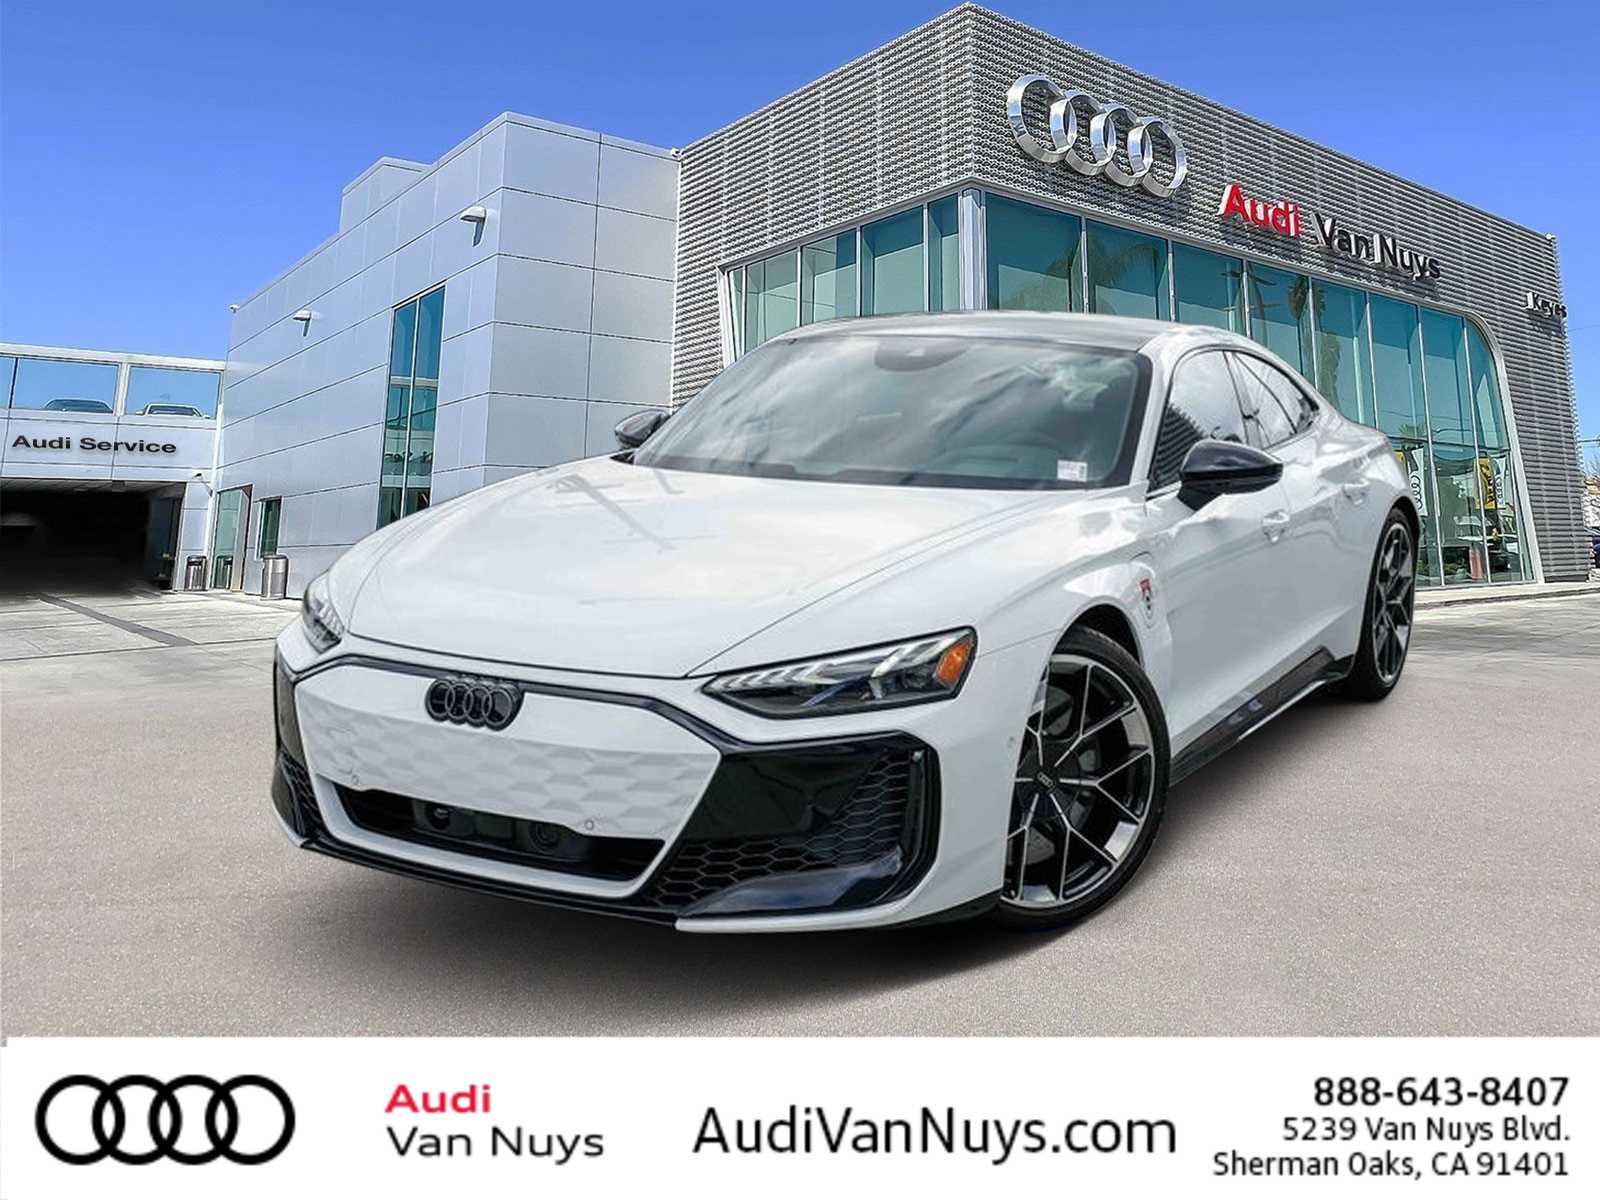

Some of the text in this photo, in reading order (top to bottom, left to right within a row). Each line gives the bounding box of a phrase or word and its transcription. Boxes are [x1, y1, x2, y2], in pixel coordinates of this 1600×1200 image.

[1216, 183, 1441, 281] Audi Van Nuys
[1526, 291, 1568, 319] Keyes
[12, 435, 177, 454] Audi Service
